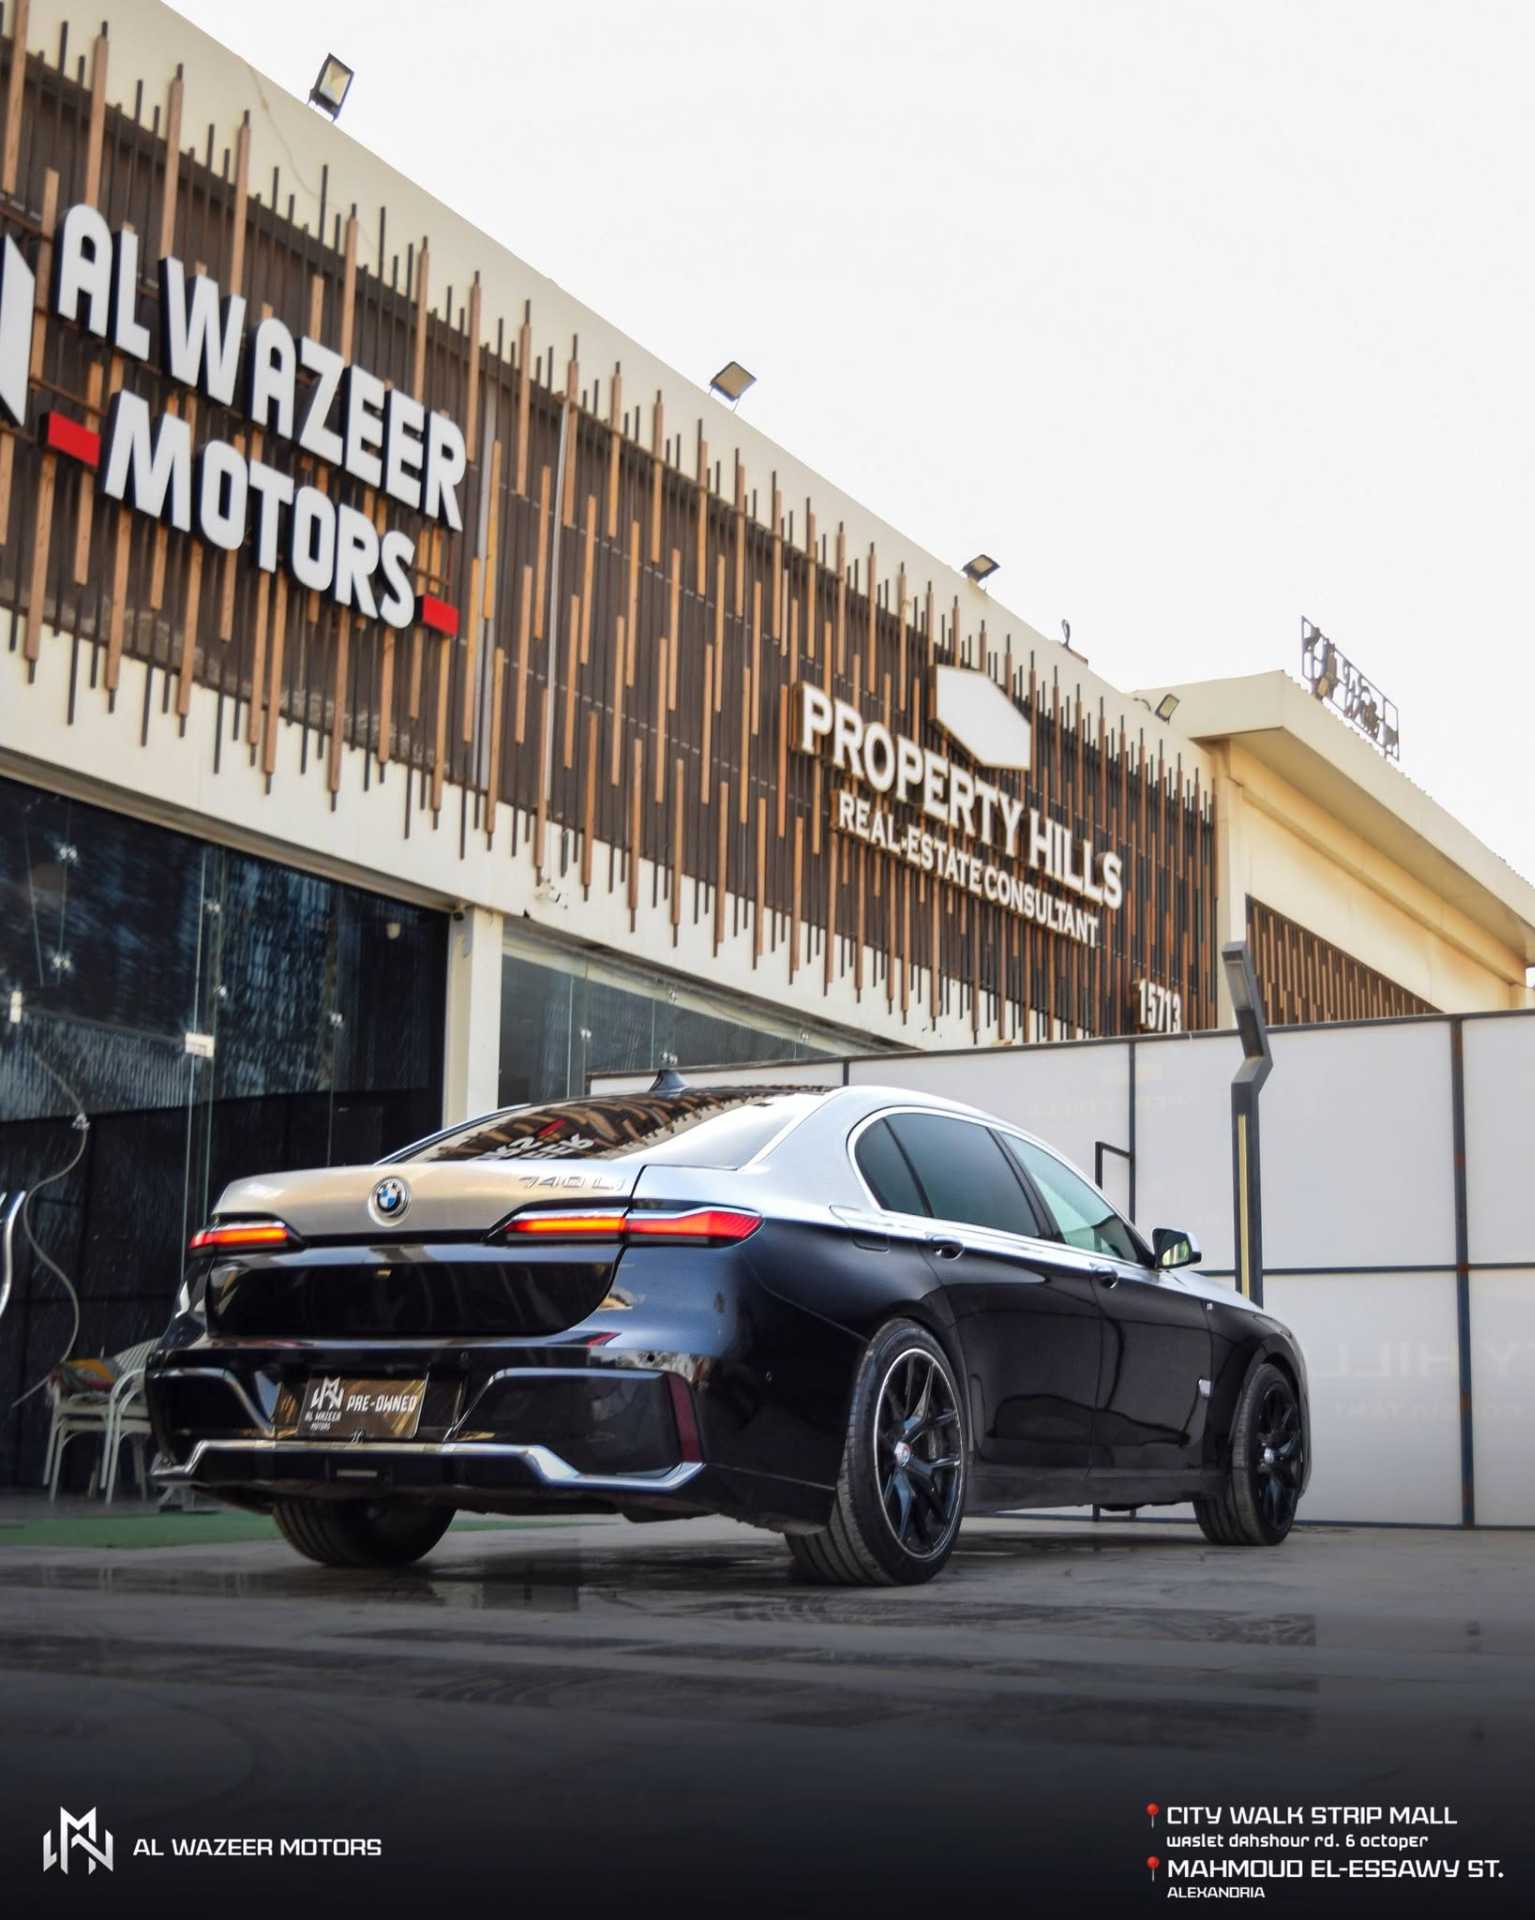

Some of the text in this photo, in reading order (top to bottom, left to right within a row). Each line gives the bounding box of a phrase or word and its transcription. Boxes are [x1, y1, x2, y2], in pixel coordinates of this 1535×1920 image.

[55, 203, 467, 532] AL WAZEER
[104, 389, 416, 630] MOTORS
[801, 681, 1123, 911] PROPERTY HILLS
[983, 864, 1100, 949] CONSULTANT
[1138, 977, 1182, 1034] 15713
[345, 1394, 418, 1412] PRE-OWNED
